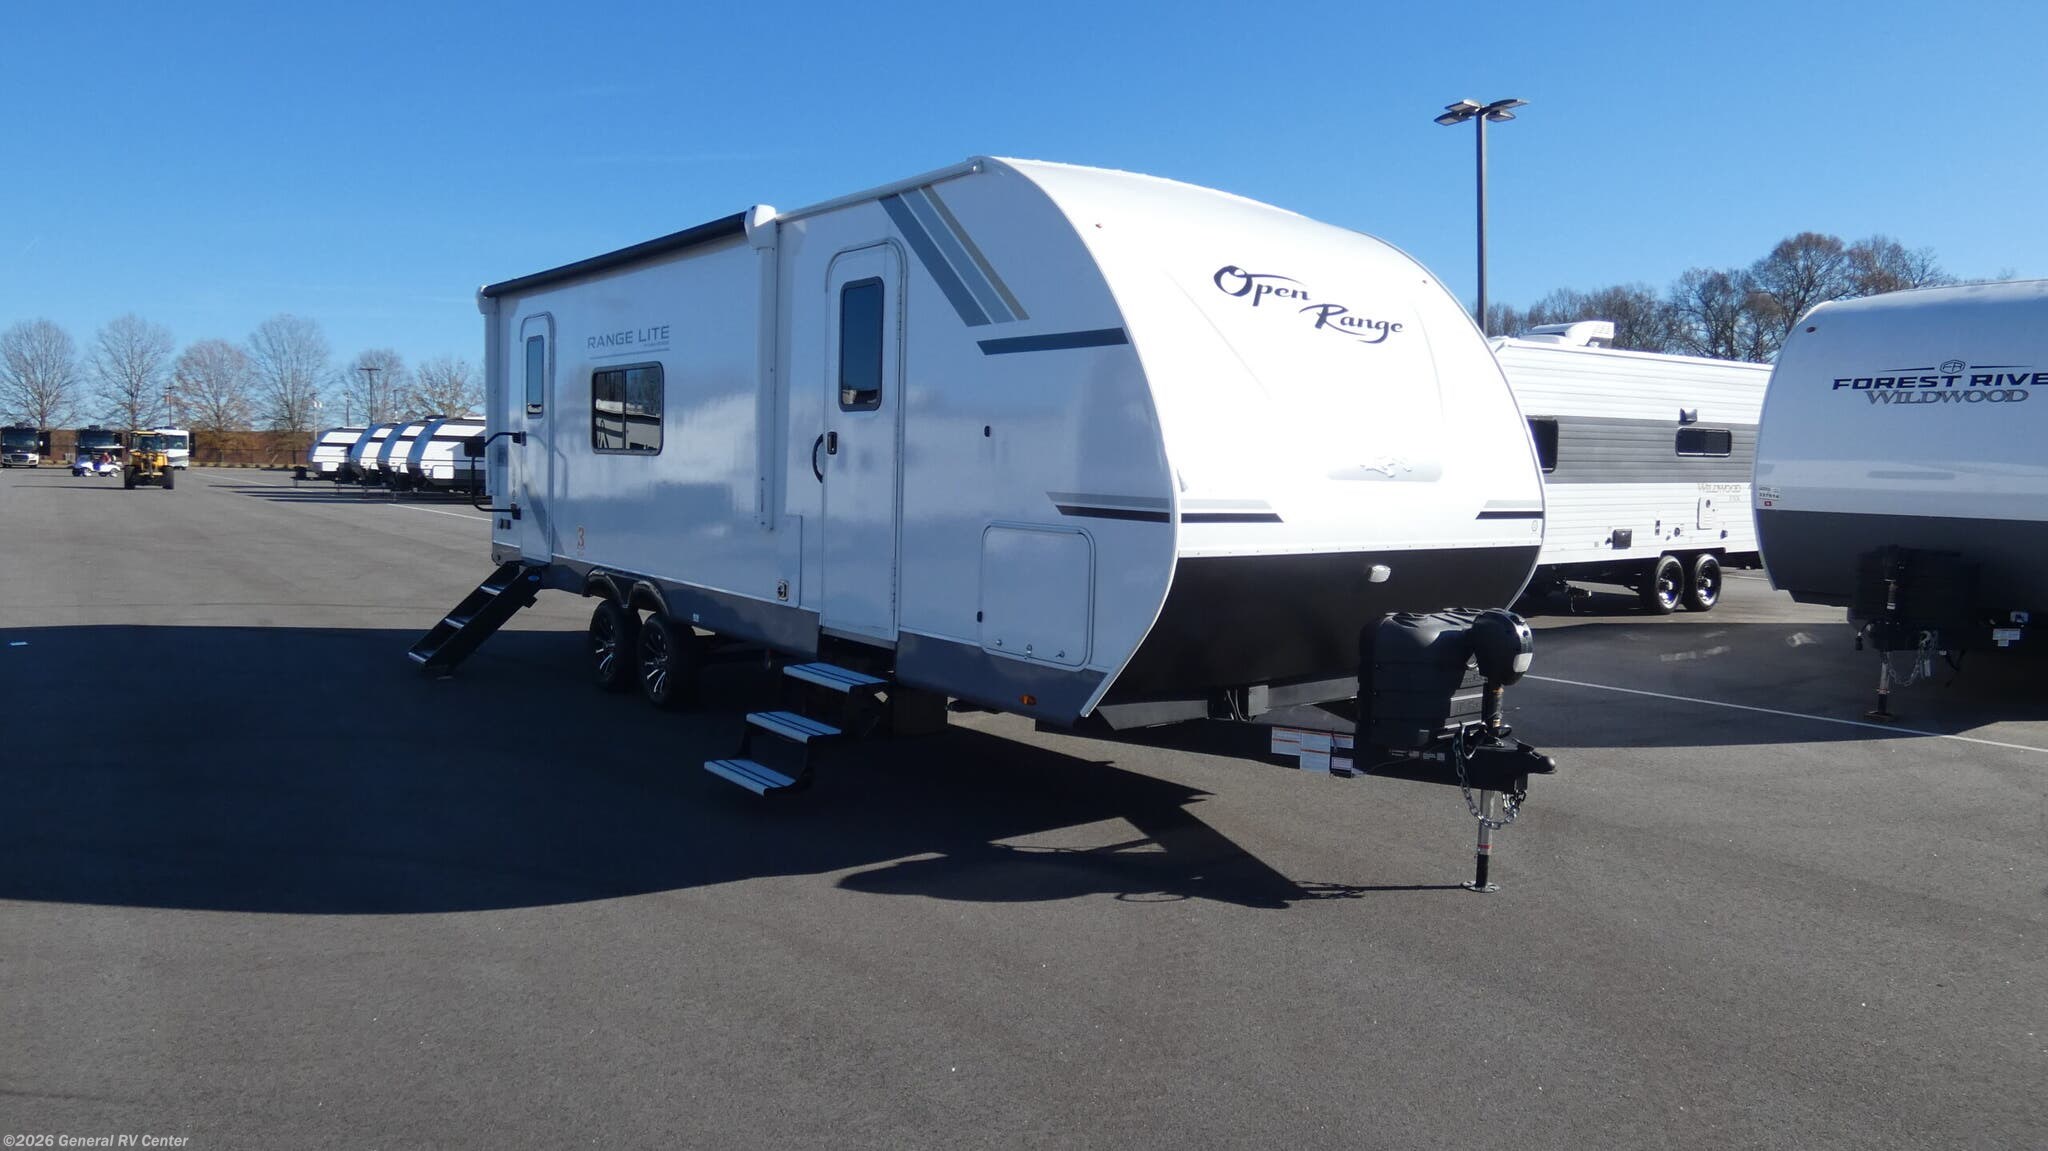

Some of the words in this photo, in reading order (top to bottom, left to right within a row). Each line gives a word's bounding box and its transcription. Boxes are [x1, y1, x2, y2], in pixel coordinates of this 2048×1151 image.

[1213, 264, 1311, 307] Open
[1298, 303, 1404, 344] Range
[587, 330, 633, 349] RANGE
[638, 325, 670, 342] LITE
[1832, 375, 1962, 390] FOREST
[1864, 388, 2029, 405] WILDWOOD
